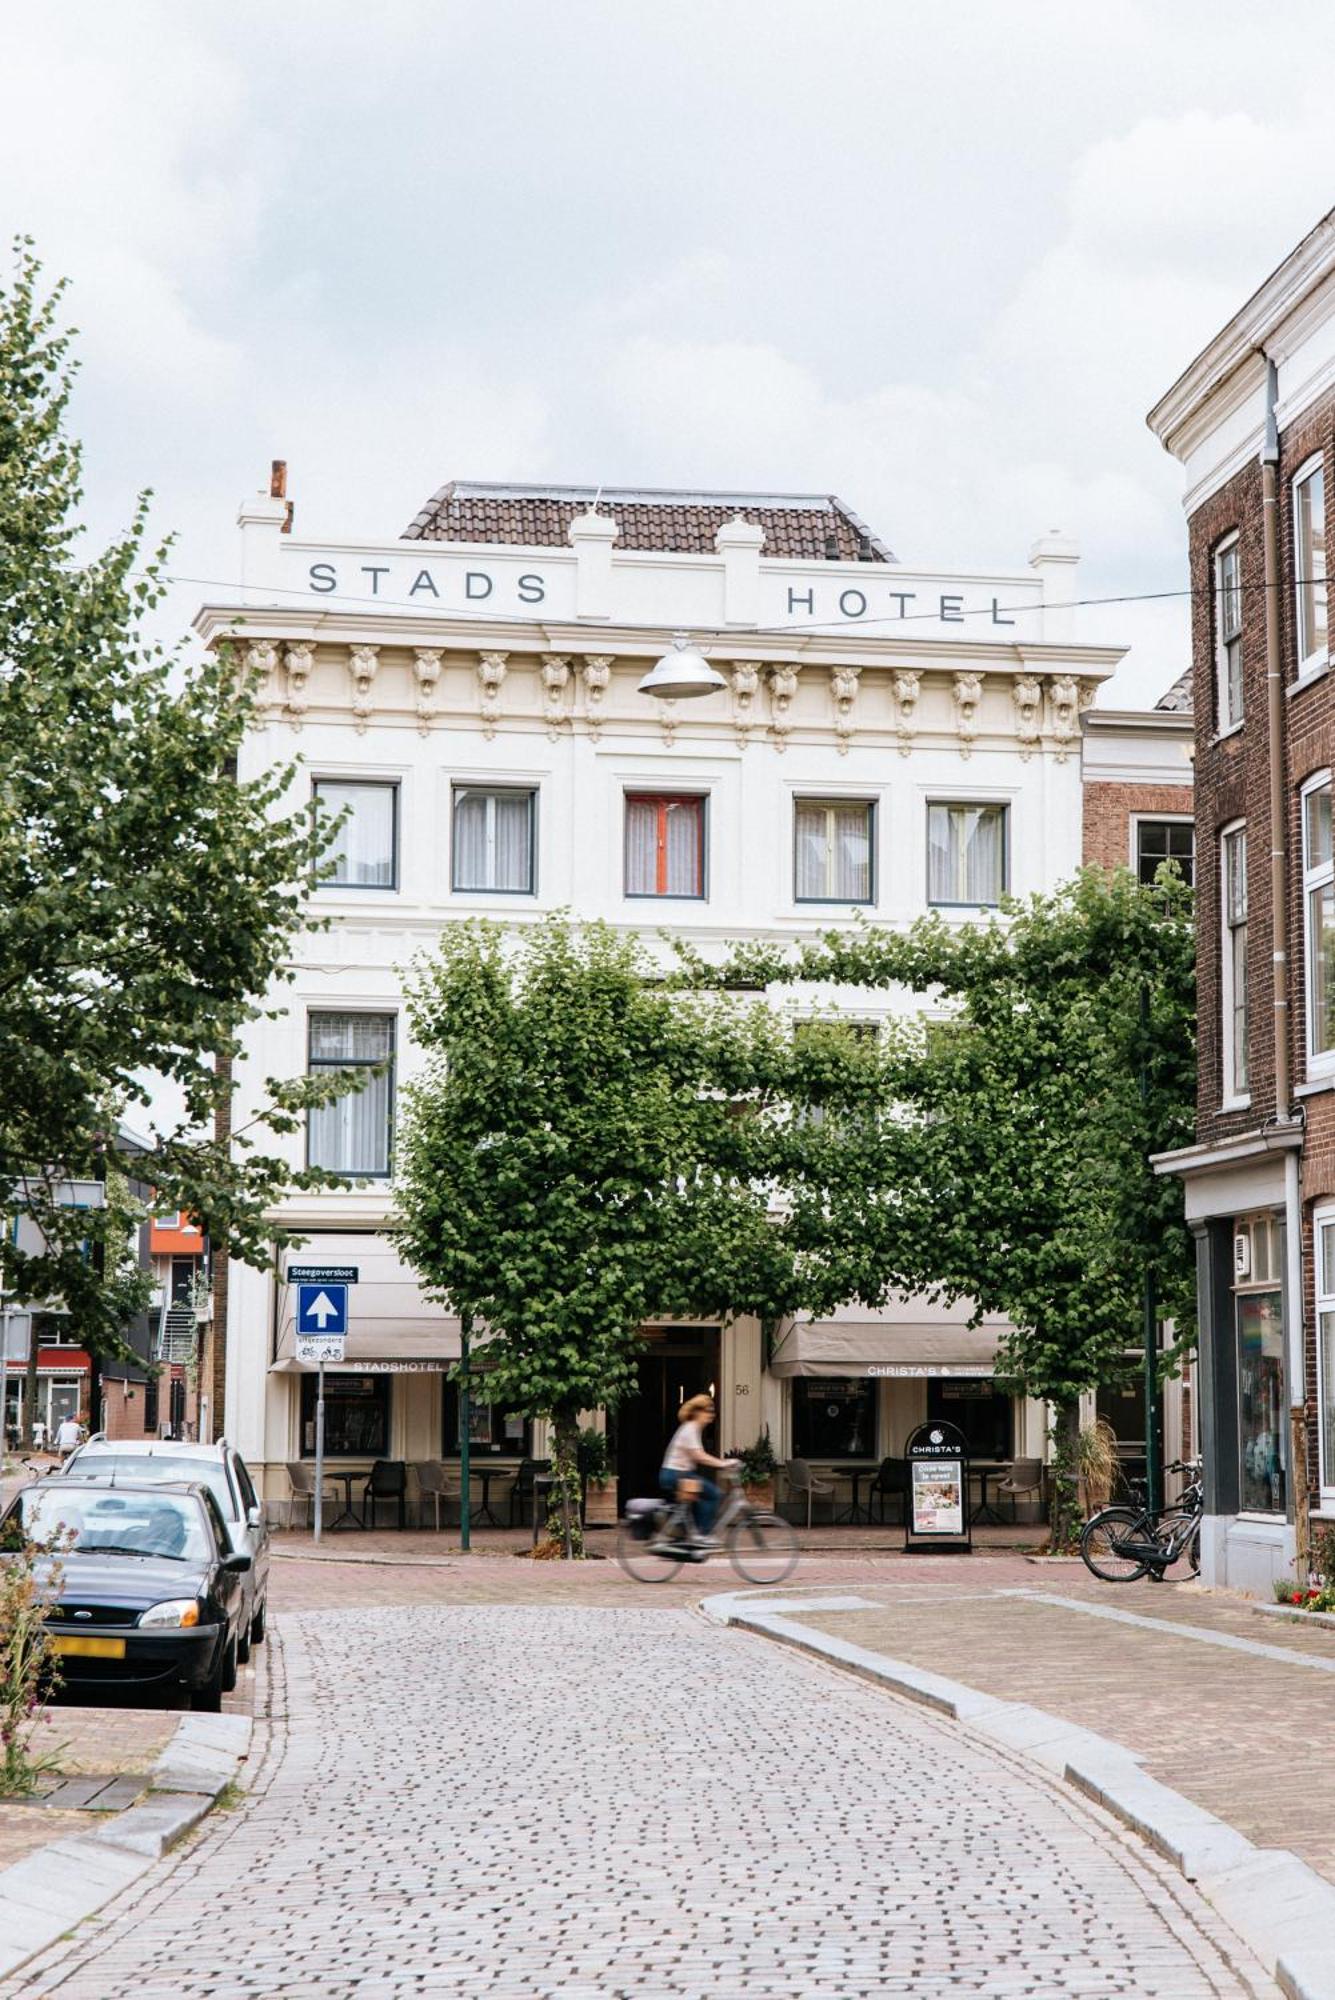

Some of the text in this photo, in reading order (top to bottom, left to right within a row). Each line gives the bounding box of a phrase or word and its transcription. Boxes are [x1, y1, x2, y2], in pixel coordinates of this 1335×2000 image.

[309, 563, 1016, 625] STADS HOTEL
[353, 1362, 443, 1373] STADSHOTEL
[867, 1366, 937, 1376] CHRISTA'S
[735, 1384, 750, 1396] 56
[911, 1445, 961, 1454] CHRISTA'S
